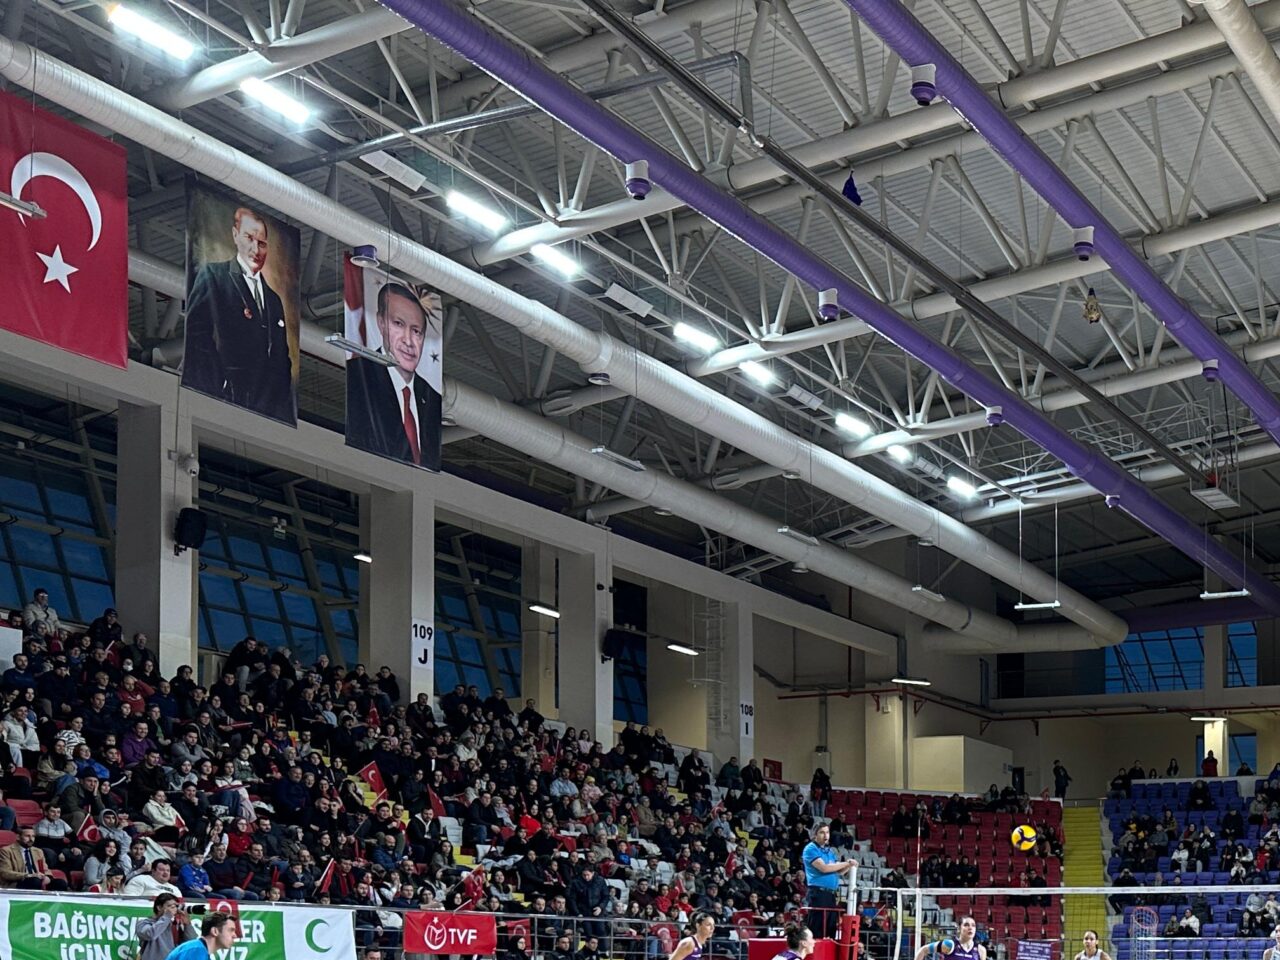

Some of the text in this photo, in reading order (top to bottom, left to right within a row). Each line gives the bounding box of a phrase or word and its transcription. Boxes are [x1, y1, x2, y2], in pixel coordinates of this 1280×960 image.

[412, 624, 433, 641] 109
[417, 648, 428, 665] J
[740, 703, 754, 716] 108
[449, 928, 478, 945] TVF
